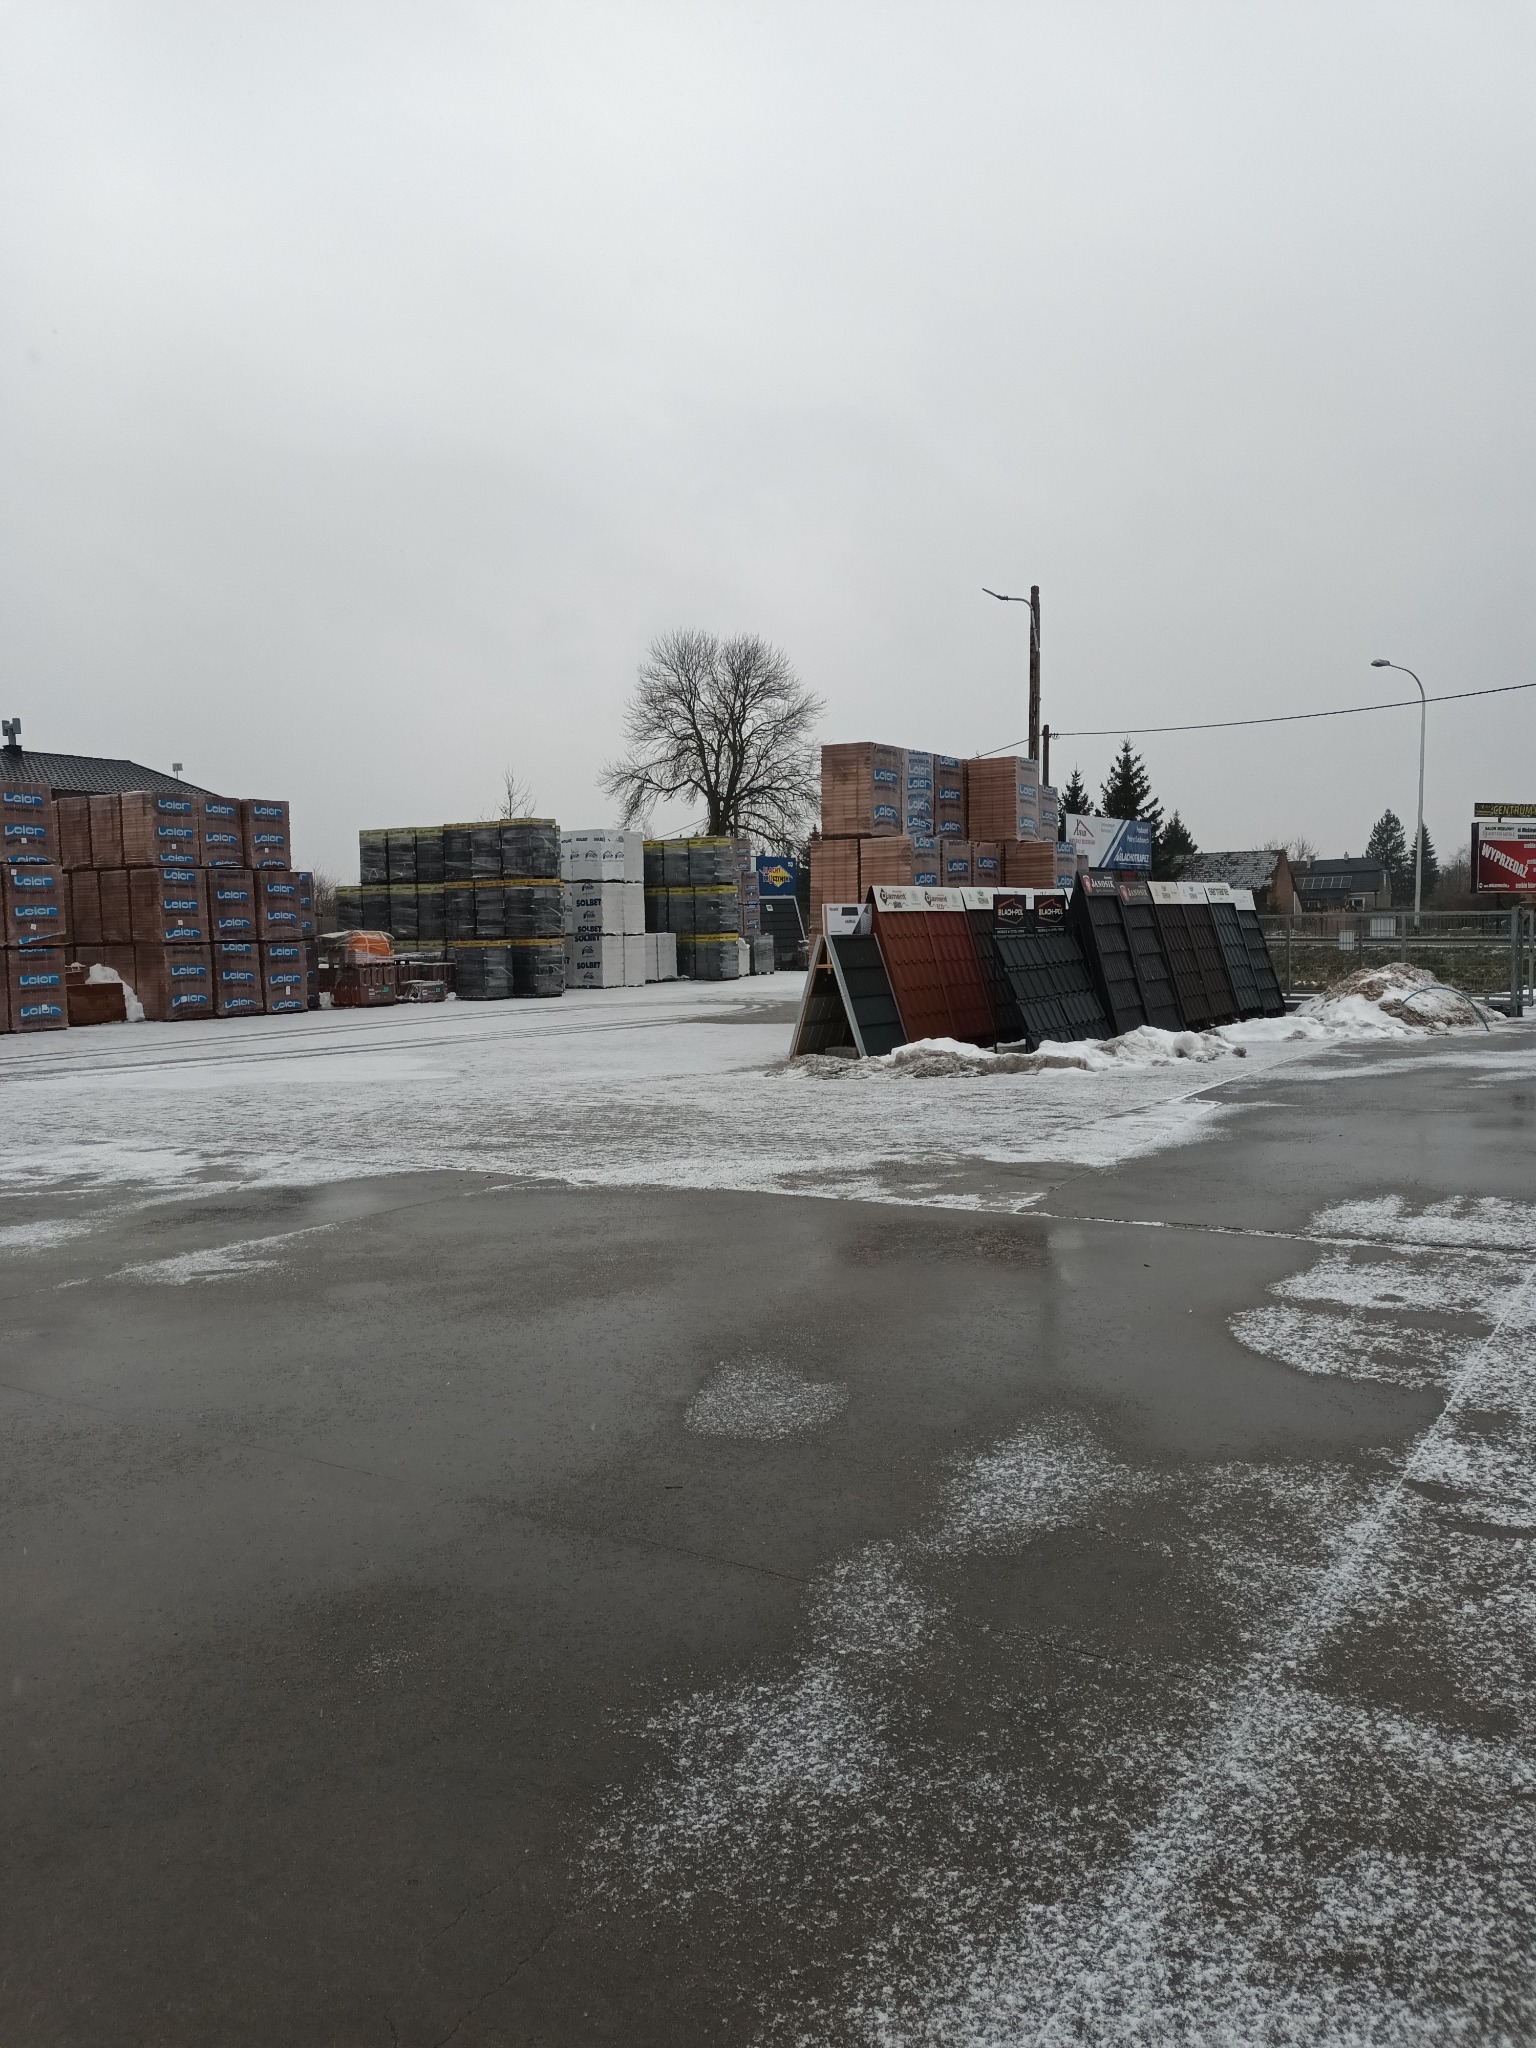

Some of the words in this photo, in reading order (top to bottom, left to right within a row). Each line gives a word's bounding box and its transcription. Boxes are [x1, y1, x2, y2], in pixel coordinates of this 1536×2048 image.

[874, 769, 898, 782] Leier
[3, 792, 43, 804] Leier
[939, 788, 961, 800] Leier
[157, 799, 191, 810] Leier
[205, 803, 235, 815] Leier
[253, 806, 283, 816] Leier
[874, 805, 899, 820] Leier
[907, 816, 932, 828] Leier
[940, 821, 962, 832] Leier
[4, 825, 46, 836] Leier
[158, 826, 193, 837] Leier
[205, 833, 238, 843] Leier
[254, 834, 284, 844] Leier
[160, 854, 194, 862] Leier
[977, 857, 998, 869] Leier
[1481, 842, 1529, 879] WYPRZEDAŻ
[947, 860, 969, 872] Leier
[164, 869, 195, 880] Leier
[914, 873, 937, 886] Leier
[14, 875, 53, 887] Leier
[267, 884, 295, 893] Leier
[217, 890, 248, 899] Leier
[164, 900, 198, 909] Leier
[576, 899, 602, 907] SOLBET
[15, 906, 58, 917] Leier
[267, 911, 297, 921] Leier
[218, 918, 250, 928] Leier
[165, 928, 200, 939] Leier
[221, 944, 251, 952] Leier
[269, 947, 298, 957] Leier
[171, 966, 206, 976] Leier
[222, 971, 254, 980] Leier
[19, 975, 59, 985] Leier
[270, 974, 301, 984] Leier
[224, 998, 257, 1008] Leier
[271, 1001, 301, 1010] Leier
